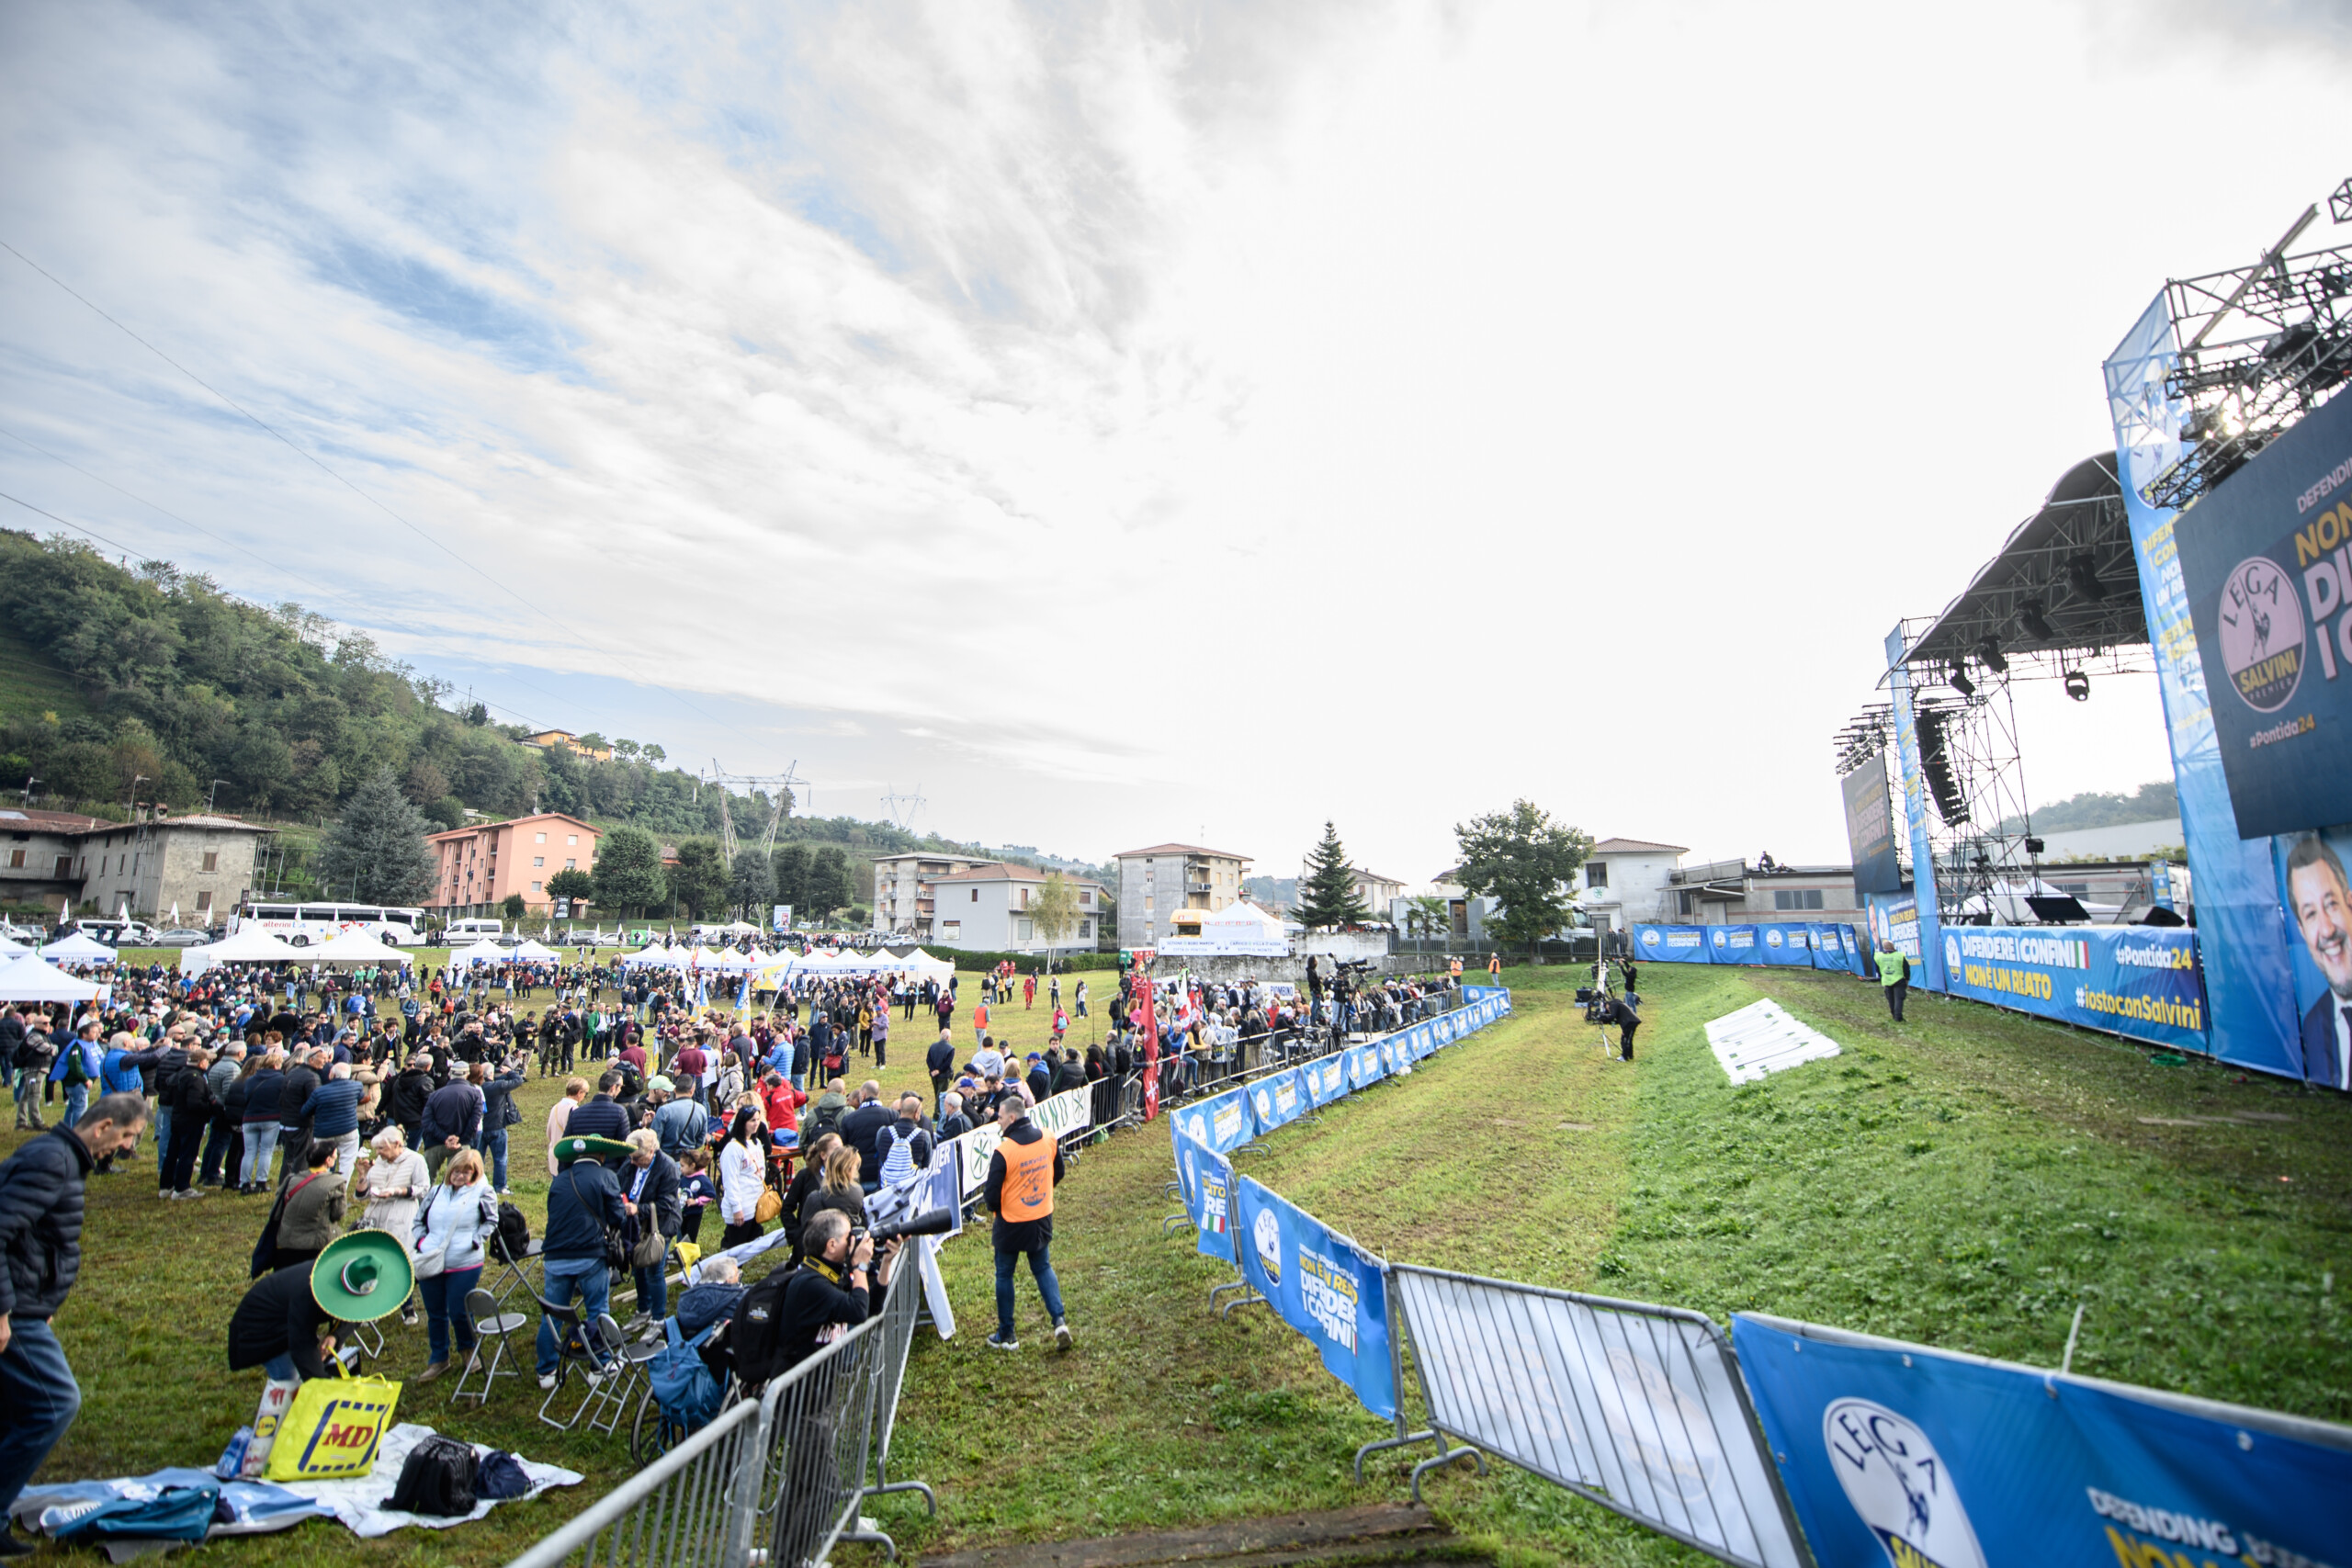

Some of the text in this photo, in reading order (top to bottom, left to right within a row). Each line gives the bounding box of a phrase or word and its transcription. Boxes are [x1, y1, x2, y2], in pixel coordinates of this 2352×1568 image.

[2222, 565, 2278, 628] LEGA
[2239, 649, 2298, 694] SALVINI
[2249, 713, 2315, 749] #Pontida24
[1962, 936, 2015, 961] DIFENDERE
[2021, 937, 2076, 968] CONFINI
[2115, 943, 2193, 971] #Pontida24
[1270, 986, 1294, 996] PIOMBINO
[1965, 960, 2052, 1000] NON È UN REATO
[2075, 983, 2202, 1030] #iostoconSalvini
[1333, 1275, 1358, 1305] REAO
[1307, 1294, 1351, 1350] COFINI
[322, 1424, 374, 1449] MD
[1833, 1412, 1939, 1495] LEGA
[2086, 1486, 2238, 1555] DEFENDING
